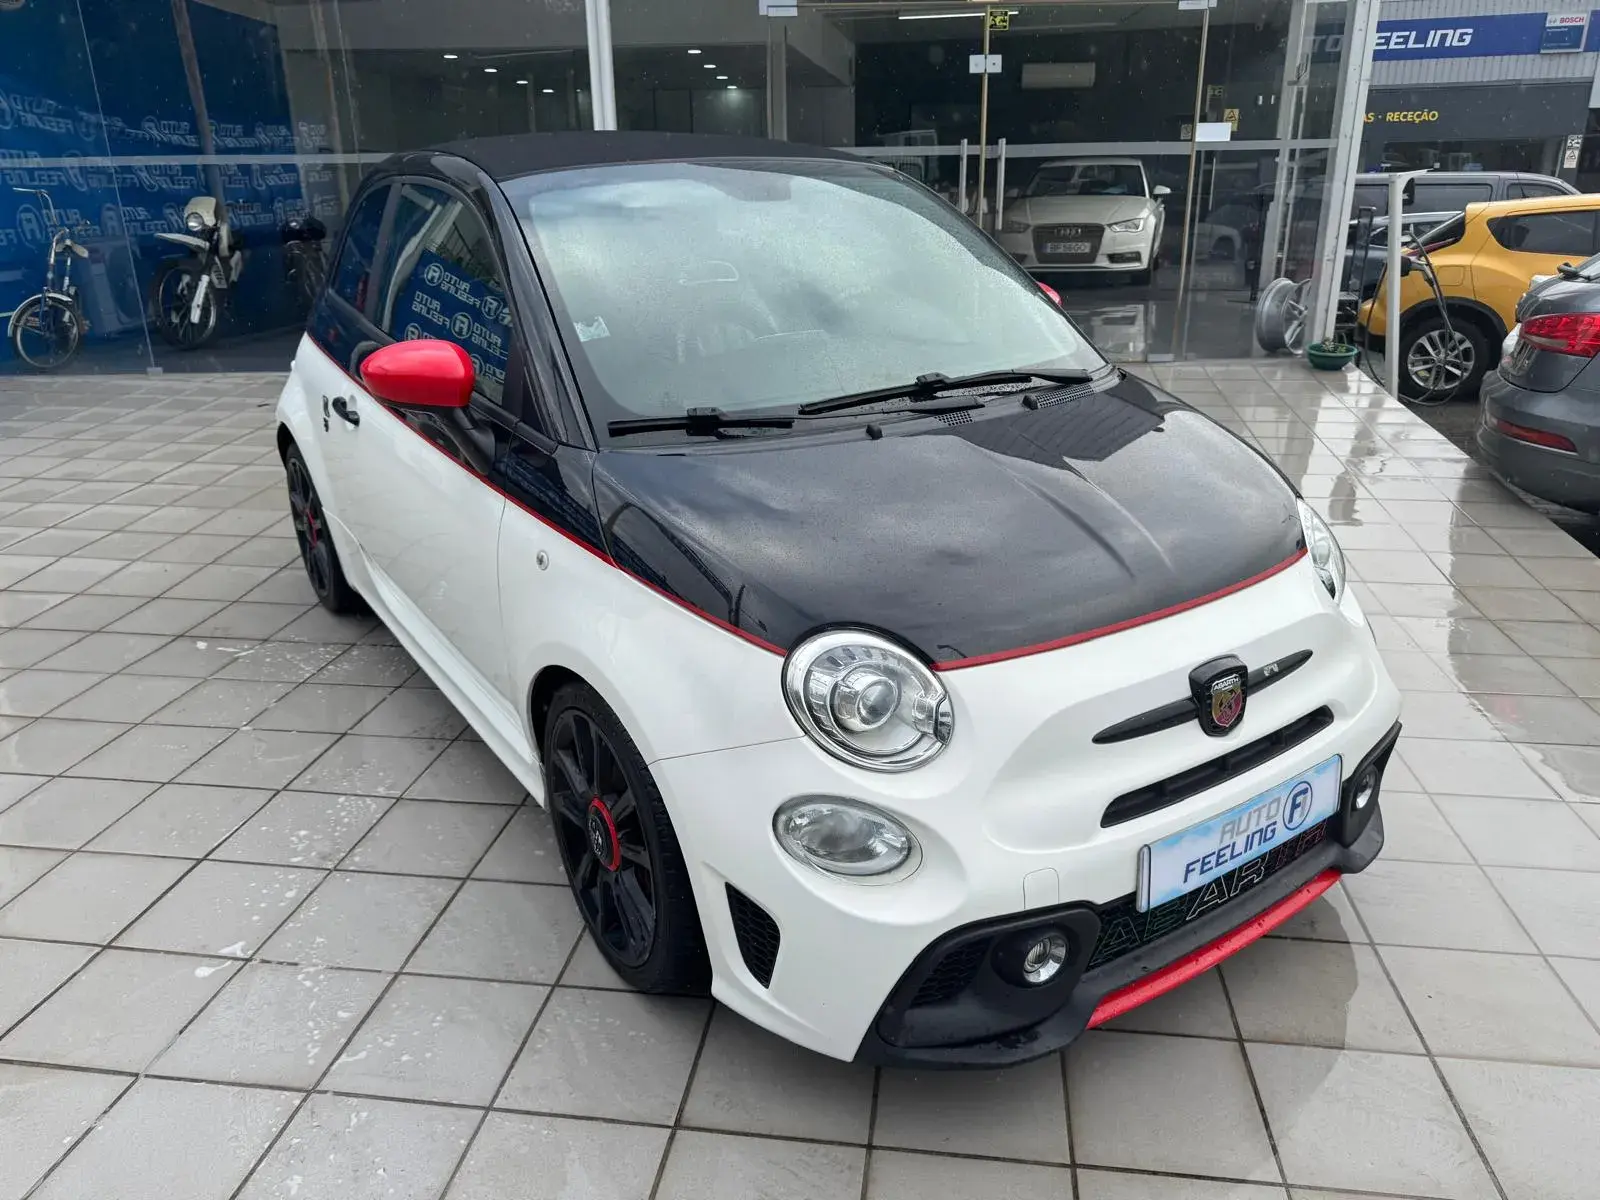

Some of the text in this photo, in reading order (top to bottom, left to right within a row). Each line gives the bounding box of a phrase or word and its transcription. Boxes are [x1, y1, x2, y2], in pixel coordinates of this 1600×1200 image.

[1374, 28, 1473, 50] EELING
[1386, 108, 1439, 124] RECEÇÃO
[1213, 678, 1239, 691] ABARTH
[1220, 796, 1281, 843] AUTO
[1183, 820, 1278, 884] FEELING
